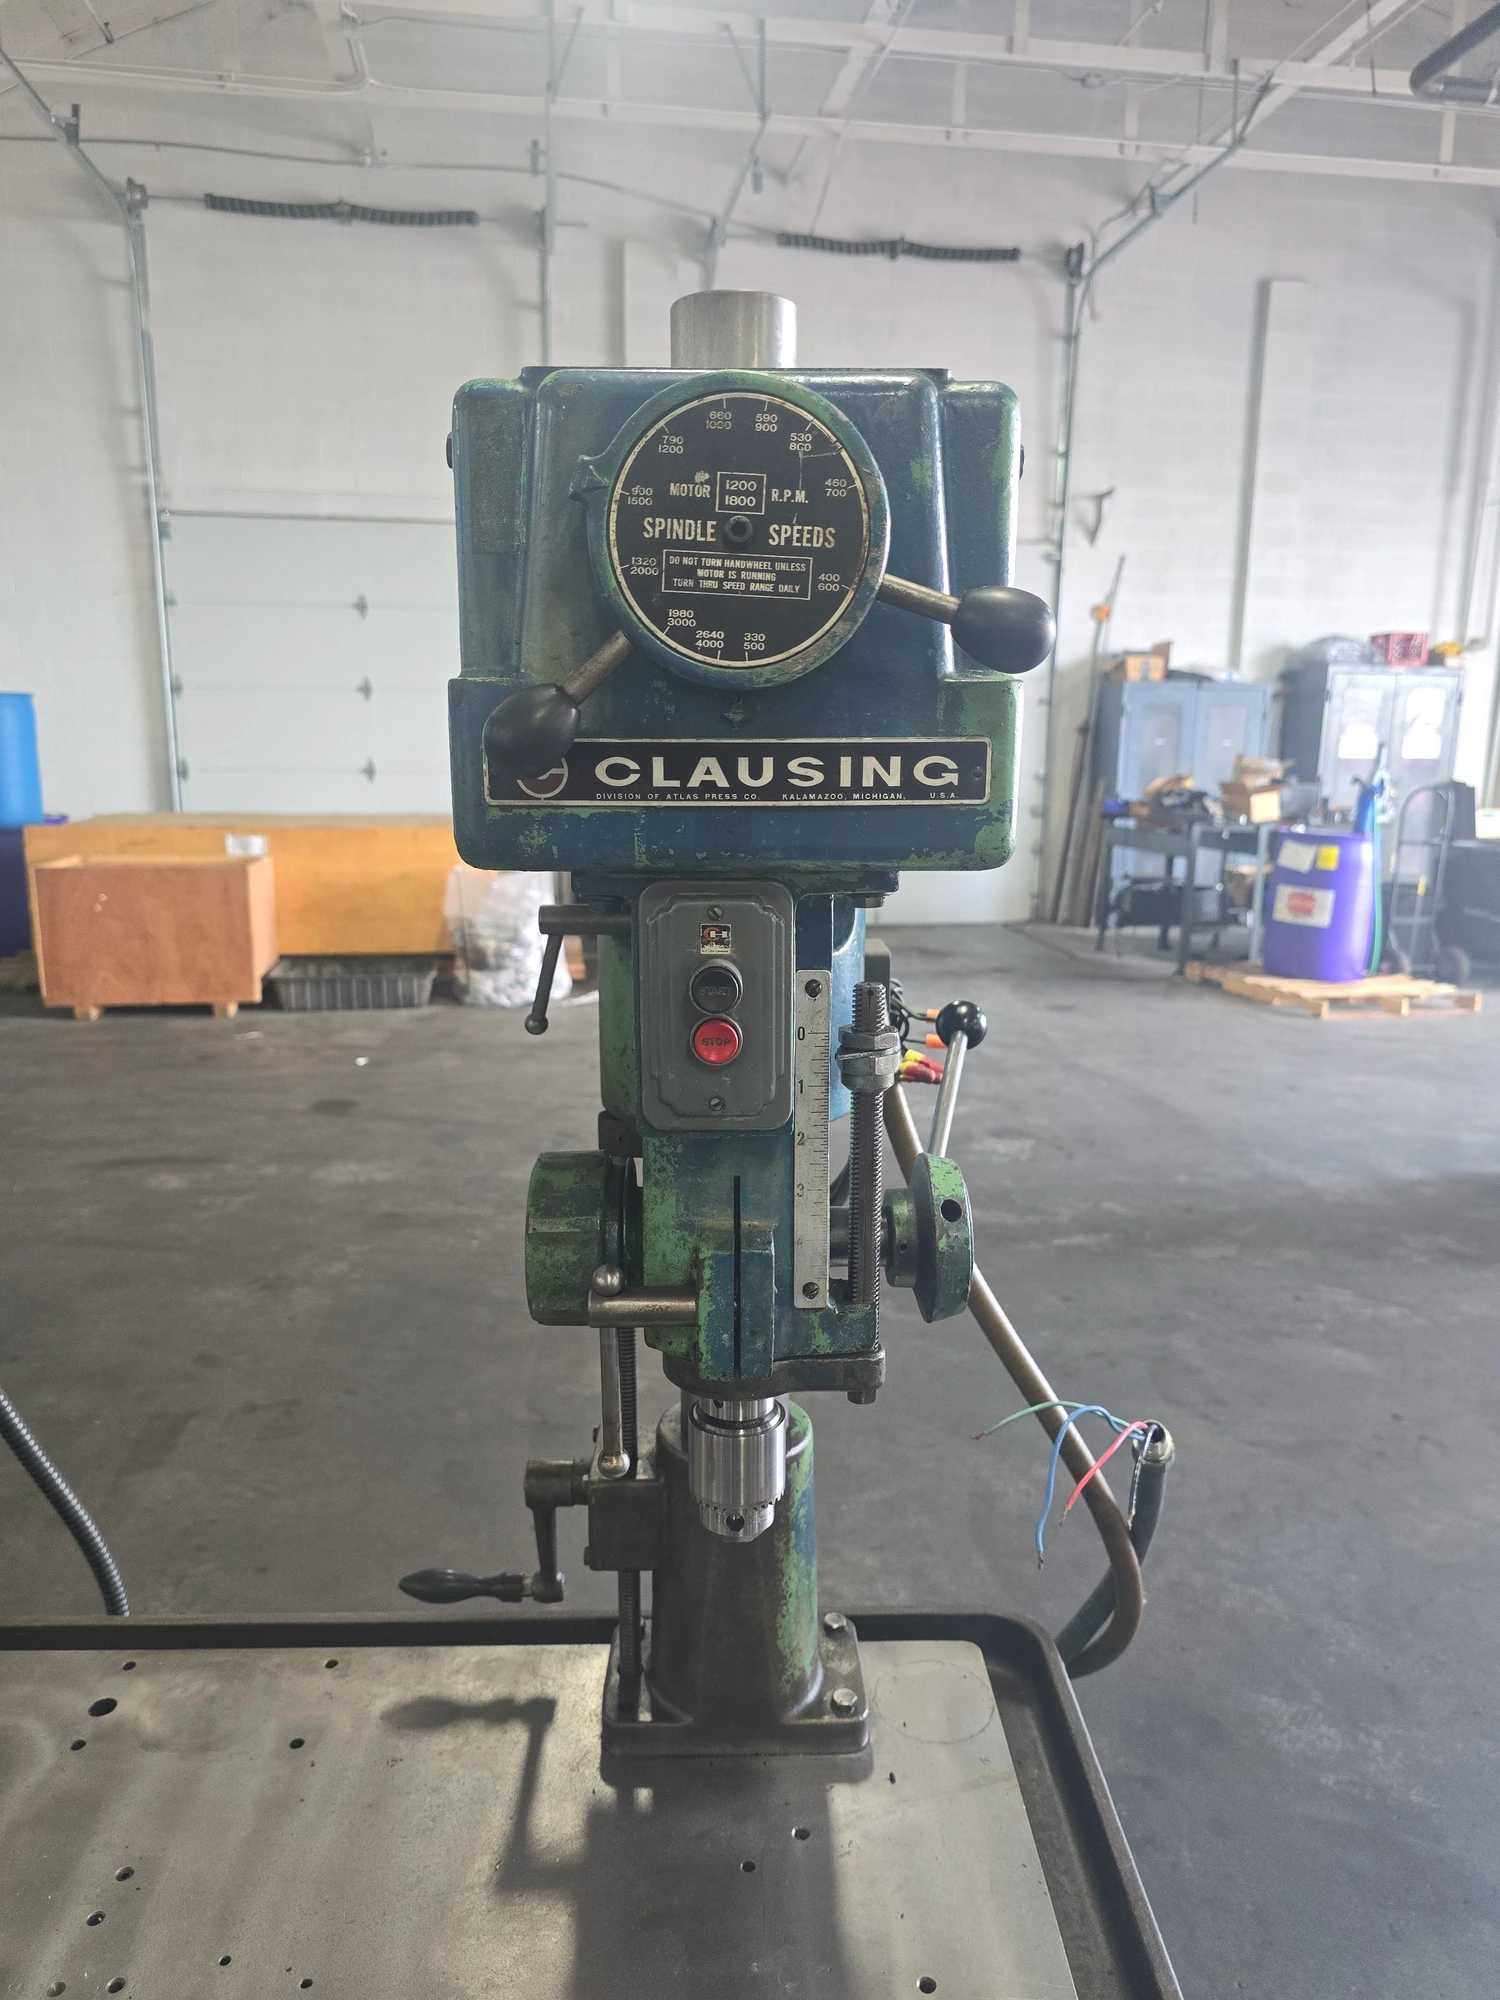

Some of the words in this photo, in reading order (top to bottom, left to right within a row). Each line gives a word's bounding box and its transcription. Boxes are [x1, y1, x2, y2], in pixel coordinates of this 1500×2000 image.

[756, 414, 778, 423] 590
[755, 423, 778, 432] 900
[662, 436, 684, 445] 790
[790, 433, 812, 442] 530
[658, 445, 684, 454] 1200
[725, 479, 757, 492] 1200
[825, 479, 847, 488] 460
[669, 482, 711, 498] MOTOR
[771, 489, 809, 504] R.P.M.
[825, 488, 847, 497] 700
[627, 497, 653, 506] 1500
[725, 495, 757, 507] 1800
[643, 517, 717, 542] SPINDLE
[768, 524, 836, 549] SPEEDS
[631, 557, 657, 566] 1320
[669, 556, 680, 565] DO
[682, 557, 699, 566] NOT
[701, 558, 722, 568] TURN
[724, 560, 773, 571] HANDWHEEL
[775, 562, 806, 572] UNLESS
[630, 567, 659, 576] 2000
[697, 569, 725, 579] MOTOR
[728, 571, 737, 580] IS
[741, 571, 777, 582] RUNNING
[818, 573, 840, 582] 400
[673, 578, 694, 588] TURN
[700, 580, 718, 589] THRU
[722, 581, 746, 591] SPEED
[750, 583, 774, 592] RANGE
[778, 584, 800, 594] DAILY
[817, 583, 840, 592] 600
[668, 609, 694, 619] 1980
[667, 618, 697, 628] 3000
[696, 630, 725, 640] 2640
[744, 633, 766, 642] 330
[696, 640, 725, 650] 4000
[744, 642, 765, 652] 500
[594, 755, 959, 788] CLAUSING
[797, 1026, 806, 1041] 0
[702, 1038, 731, 1047] STOP
[798, 1079, 804, 1094] 1
[797, 1131, 805, 1146] 2
[796, 1183, 805, 1198] 3
